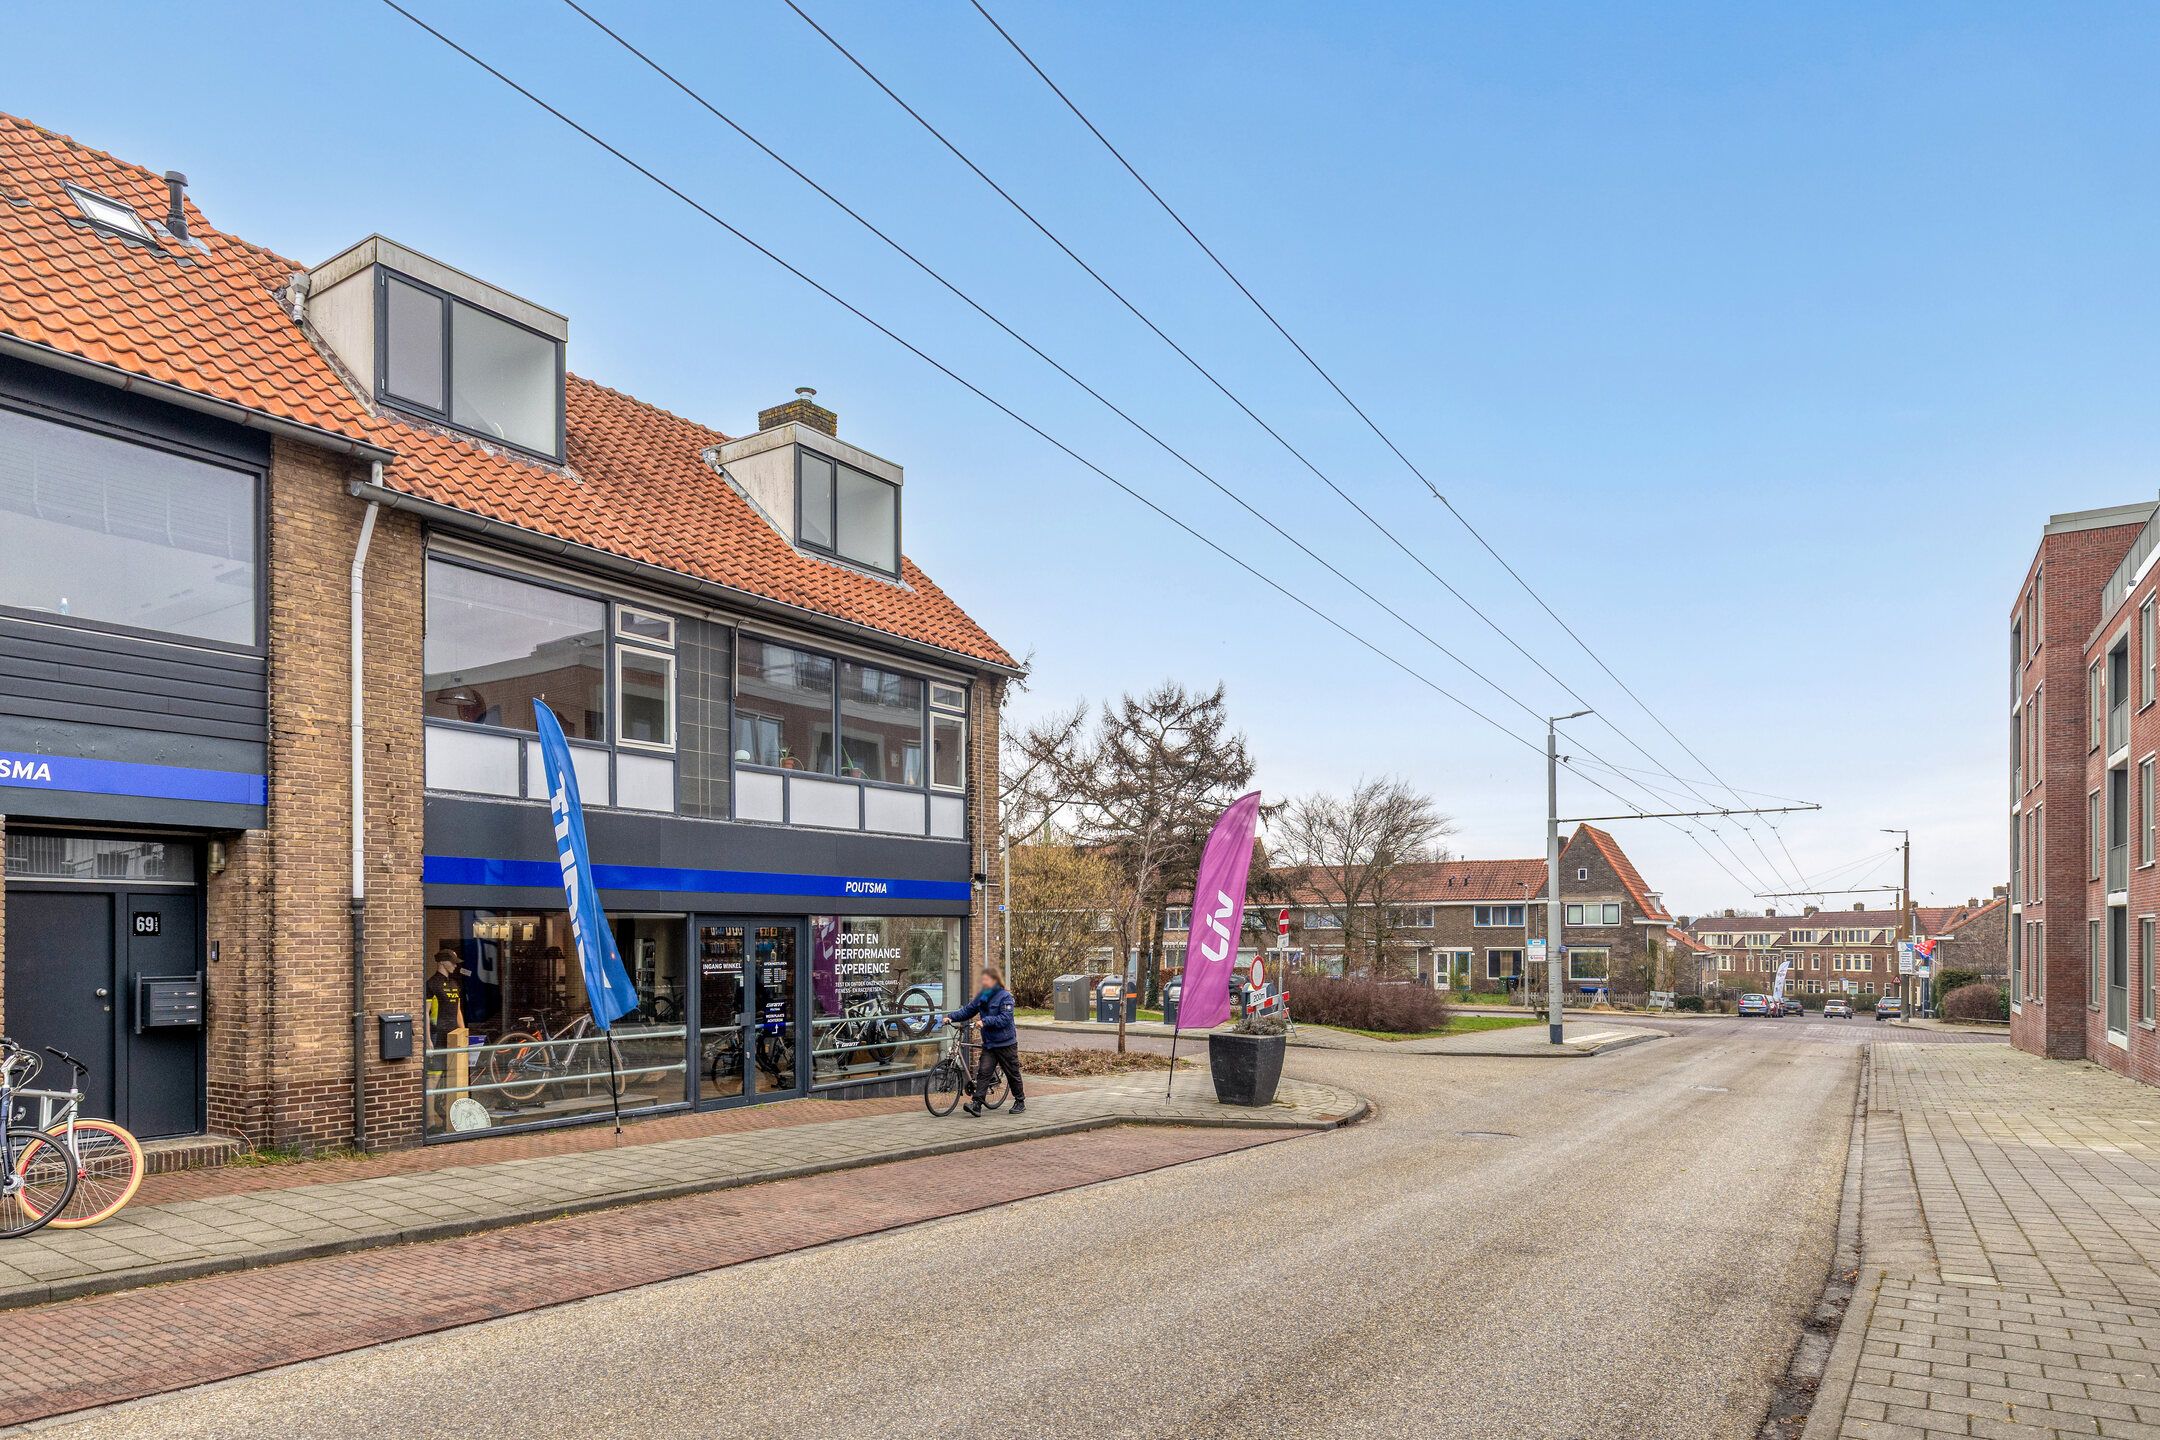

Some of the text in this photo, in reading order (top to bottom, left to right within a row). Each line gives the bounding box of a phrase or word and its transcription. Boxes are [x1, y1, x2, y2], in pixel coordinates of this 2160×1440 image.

[845, 881, 887, 893] POUTSMA
[136, 916, 154, 932] 69
[1201, 889, 1234, 962] Liv
[835, 933, 879, 944] SPORT EN
[834, 948, 901, 960] PERFORMANCE
[834, 963, 890, 975] EXPERIENCE
[394, 1031, 403, 1039] 71
